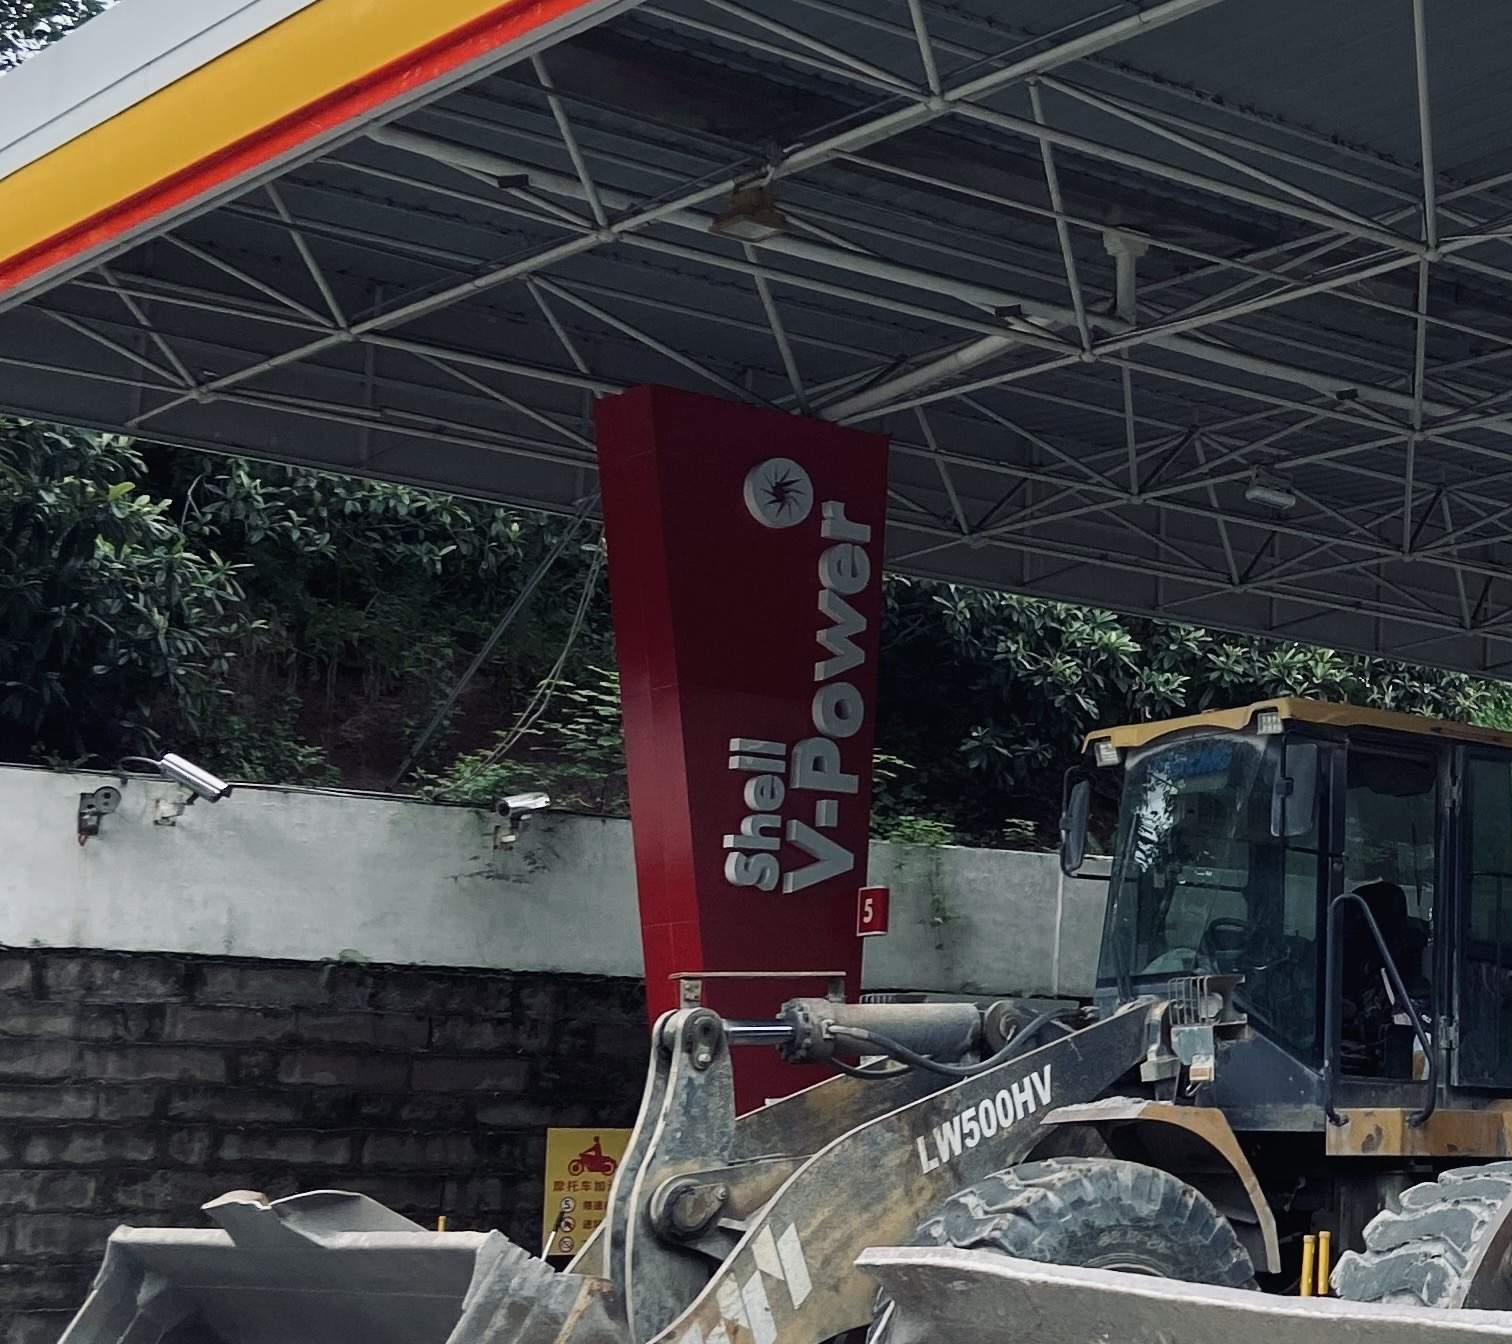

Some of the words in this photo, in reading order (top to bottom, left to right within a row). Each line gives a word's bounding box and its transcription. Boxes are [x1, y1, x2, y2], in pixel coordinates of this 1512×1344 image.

[782, 501, 871, 894] V-Power
[723, 738, 786, 892] Shell
[863, 897, 873, 924] 5
[916, 1063, 1051, 1174] LW500HV
[553, 1180, 611, 1192] 摩托车加
